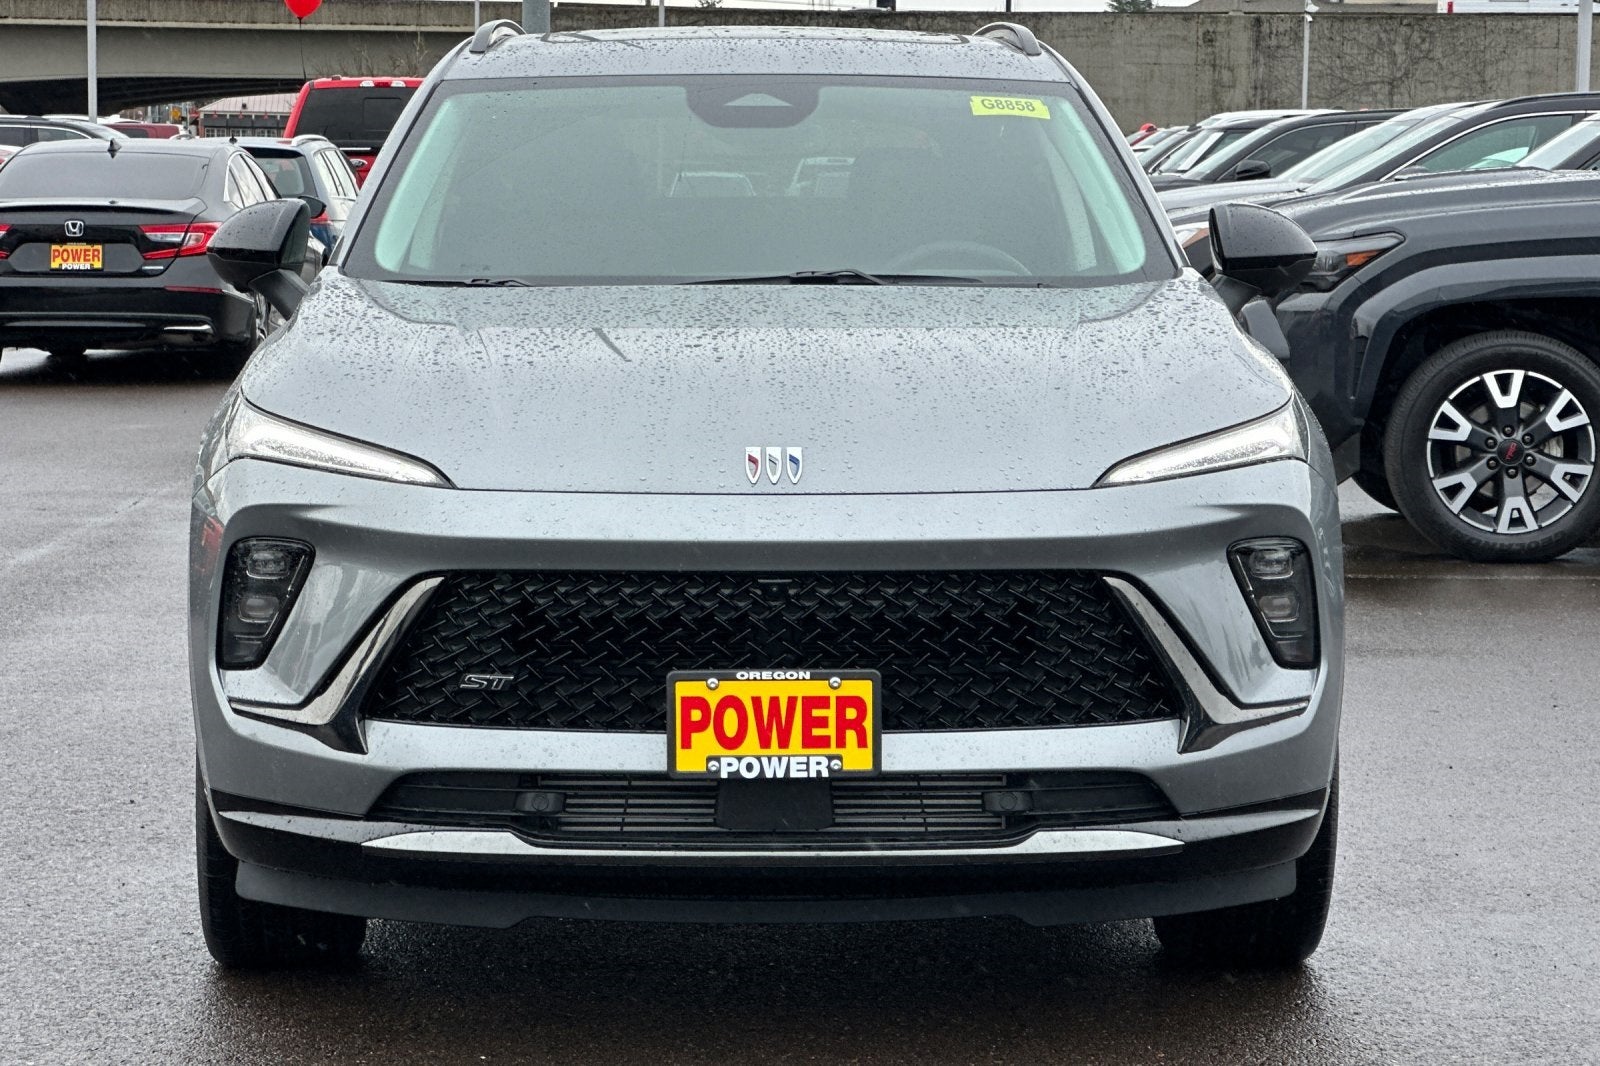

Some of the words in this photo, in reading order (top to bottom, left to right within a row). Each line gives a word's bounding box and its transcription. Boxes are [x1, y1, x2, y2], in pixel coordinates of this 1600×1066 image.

[981, 98, 1036, 112] G8858
[52, 248, 101, 263] POWER
[736, 671, 810, 680] OREGON
[680, 694, 868, 750] POWER
[720, 756, 829, 778] POWER
